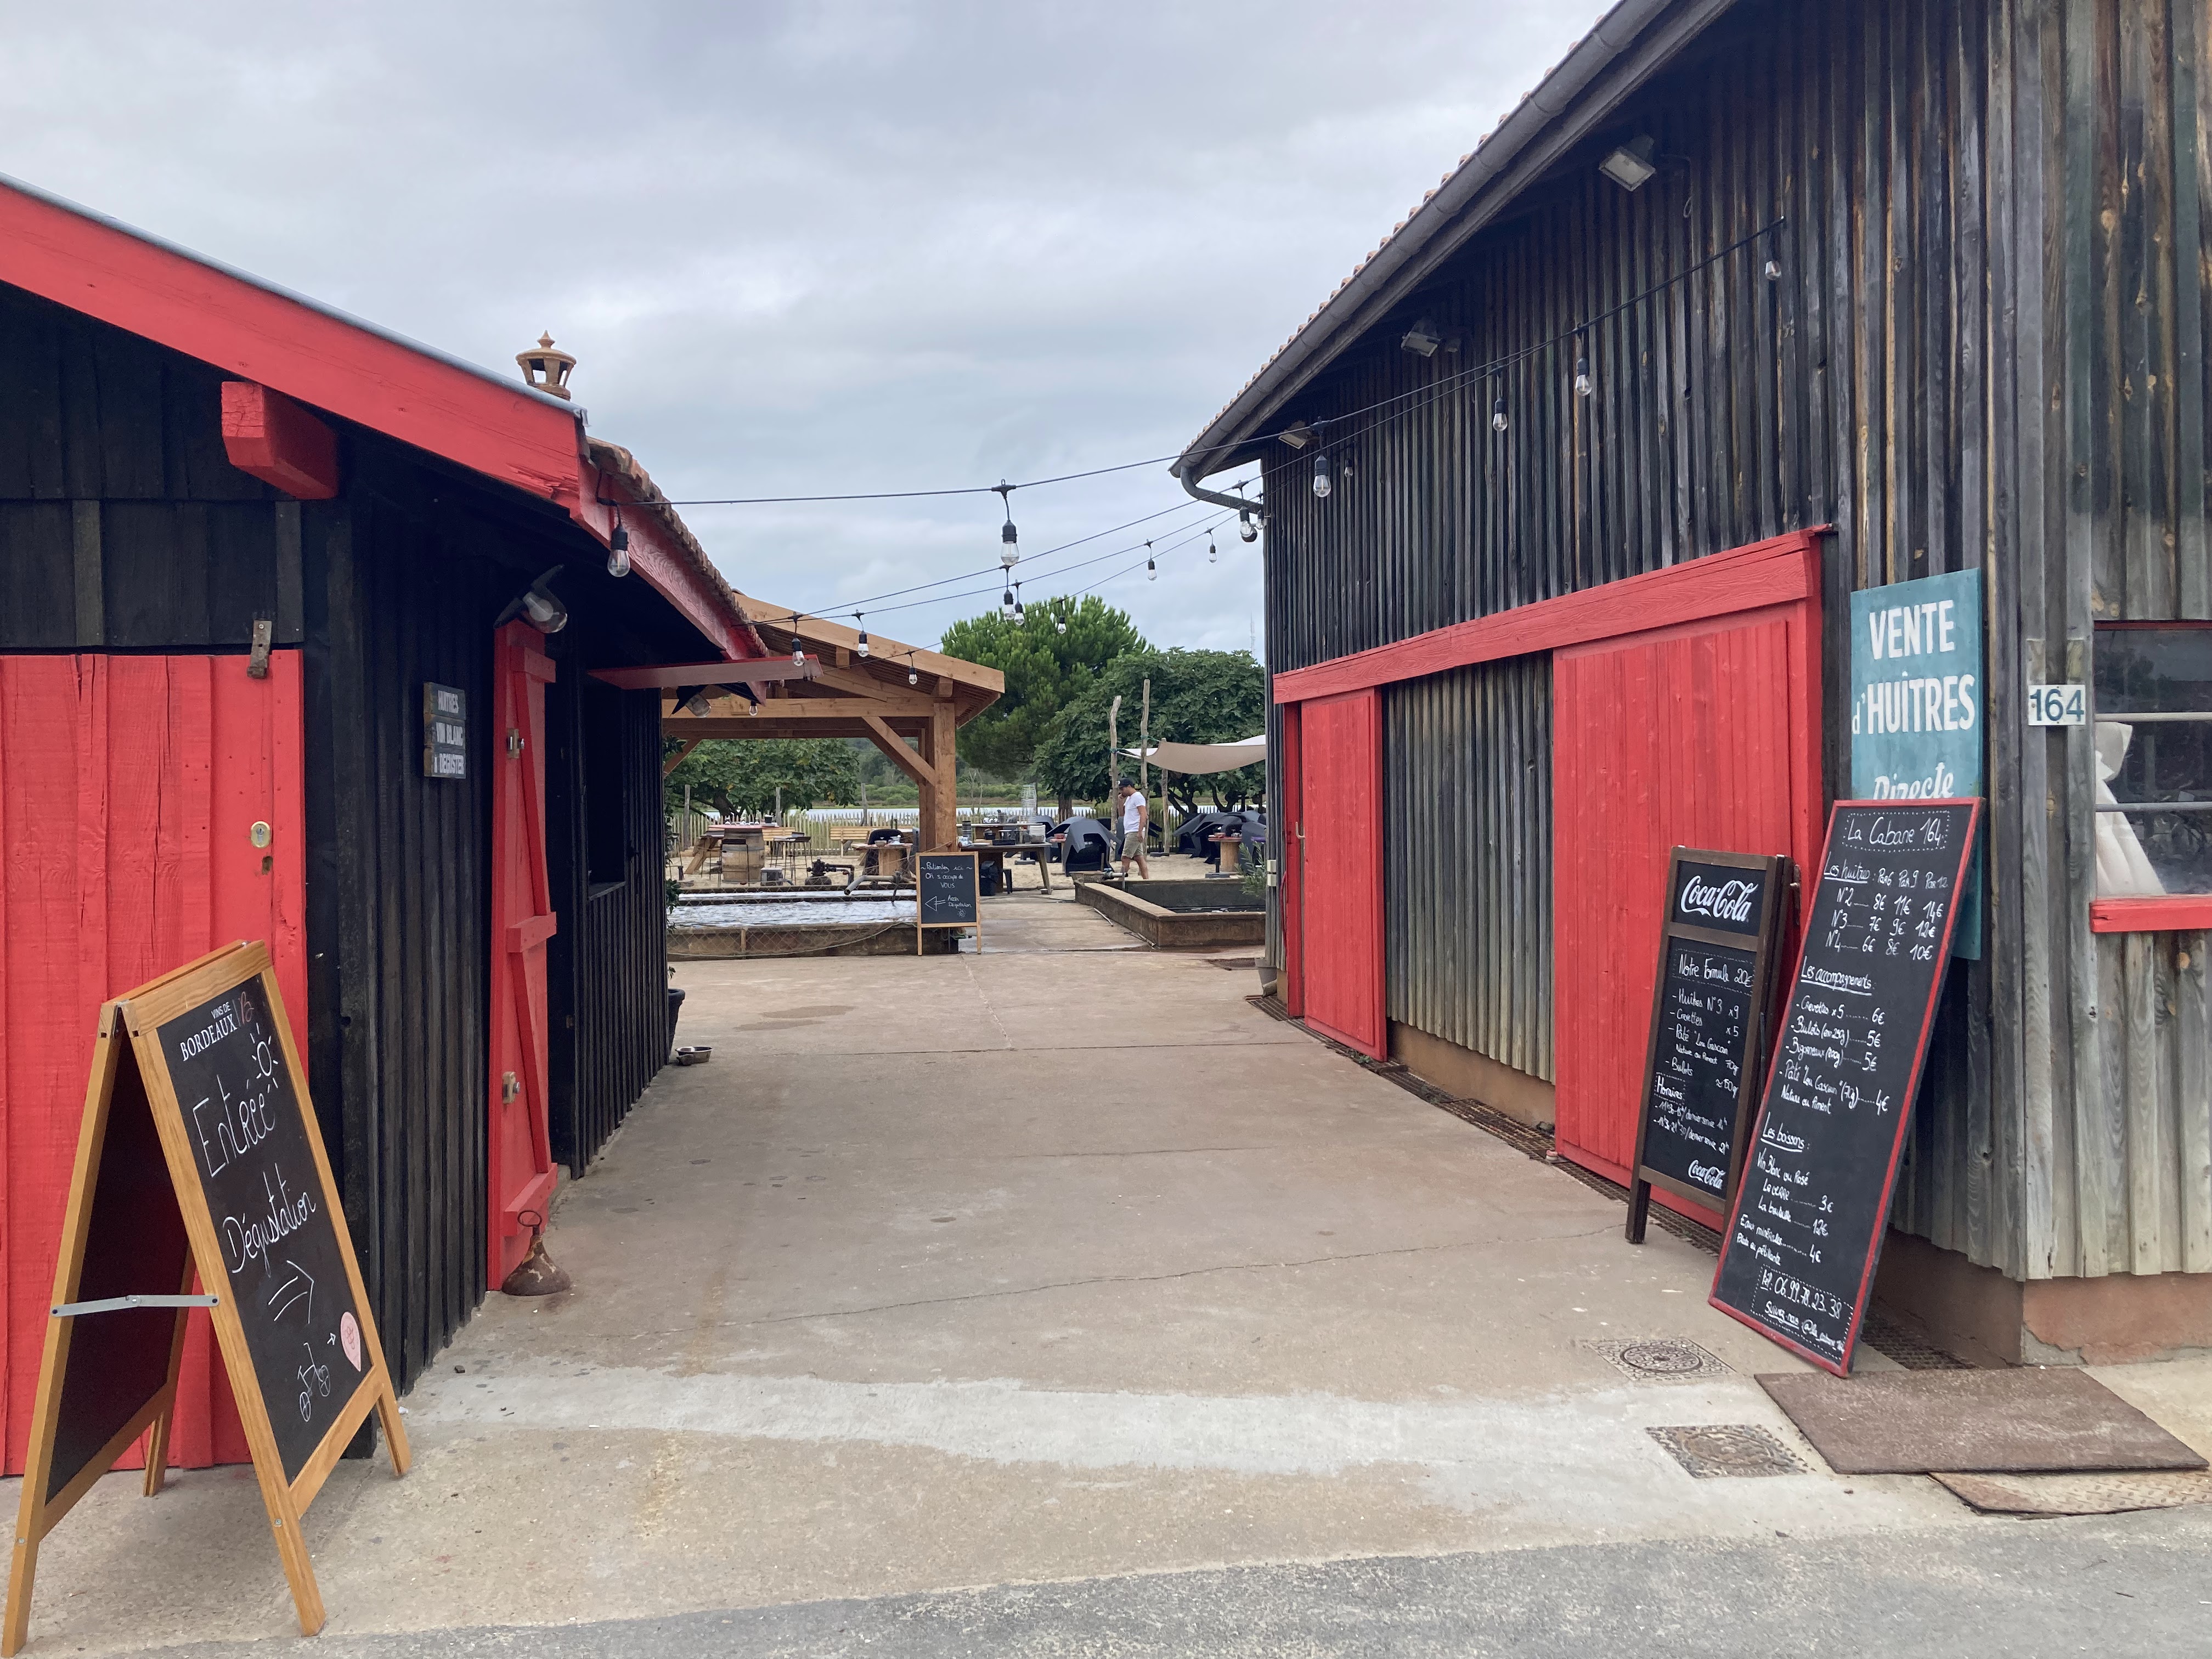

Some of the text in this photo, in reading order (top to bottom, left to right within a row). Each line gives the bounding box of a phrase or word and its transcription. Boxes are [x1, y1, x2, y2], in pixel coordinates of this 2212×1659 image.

[1869, 600, 1954, 659] VENTE
[1852, 672, 1975, 735] d'HUÎTRES
[2030, 689, 2084, 721] 164
[447, 724, 462, 746] BLANC
[1848, 817, 1940, 846] La Cabane 164
[1824, 851, 1839, 876] Les
[1681, 875, 1758, 922] Coca-Cola
[1873, 893, 1887, 911] 8€
[1894, 895, 1911, 915] 11€
[1923, 901, 1944, 923] 14€
[1869, 916, 1881, 932] 7€
[1889, 918, 1906, 936] 9€
[1915, 920, 1936, 938] 12€
[1863, 935, 1875, 952] 6€
[1886, 939, 1900, 955] 8€
[1910, 944, 1933, 960] 10€
[1679, 954, 1753, 988] Notre Formule 20€
[1801, 956, 1815, 979] Les
[211, 1006, 224, 1019] VINS
[222, 1002, 231, 1013] DE
[1677, 1008, 1702, 1026] Crevettes
[1872, 1008, 1886, 1024] 6€
[180, 1014, 238, 1062] BORDEAUX
[1793, 1015, 1820, 1036] Bulots
[1866, 1030, 1881, 1047] 5€
[1672, 1057, 1694, 1076] Bulots
[1862, 1052, 1877, 1071] 5€
[1876, 1089, 1890, 1116] 4€
[1763, 1111, 1805, 1149] Les boissons
[1688, 1160, 1726, 1190] Coca-Cola
[1757, 1148, 1767, 1170] Vin
[1794, 1170, 1810, 1186] Rosé
[1758, 1195, 1767, 1211] La
[1763, 1178, 1771, 1192] Le
[1819, 1195, 1834, 1212] 3€
[1809, 1244, 1821, 1263] 4€
